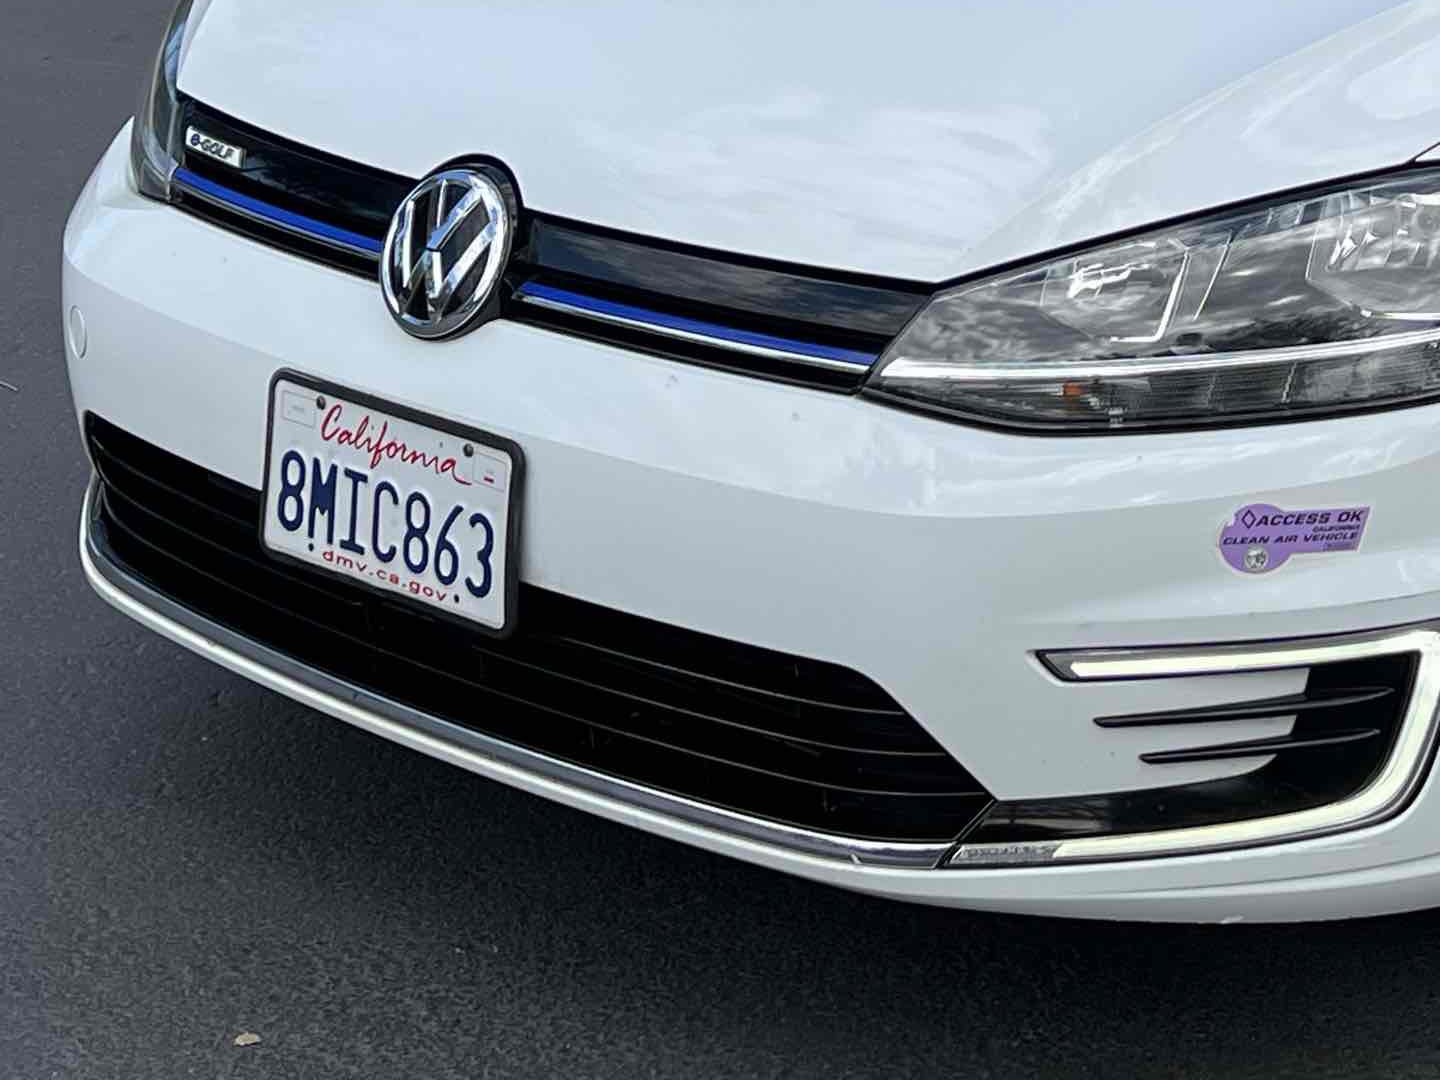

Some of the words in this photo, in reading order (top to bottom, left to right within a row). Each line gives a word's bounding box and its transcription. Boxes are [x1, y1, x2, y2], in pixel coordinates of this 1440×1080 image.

[320, 404, 472, 486] California
[277, 449, 494, 598] 8MIC863
[1223, 535, 1270, 545] CLEAN
[1273, 535, 1298, 544] AIR
[1303, 531, 1359, 543] VEHICLE
[1256, 512, 1331, 527] ACCESS
[1338, 510, 1364, 522] OK
[322, 549, 447, 602] dmv.ca.gov
